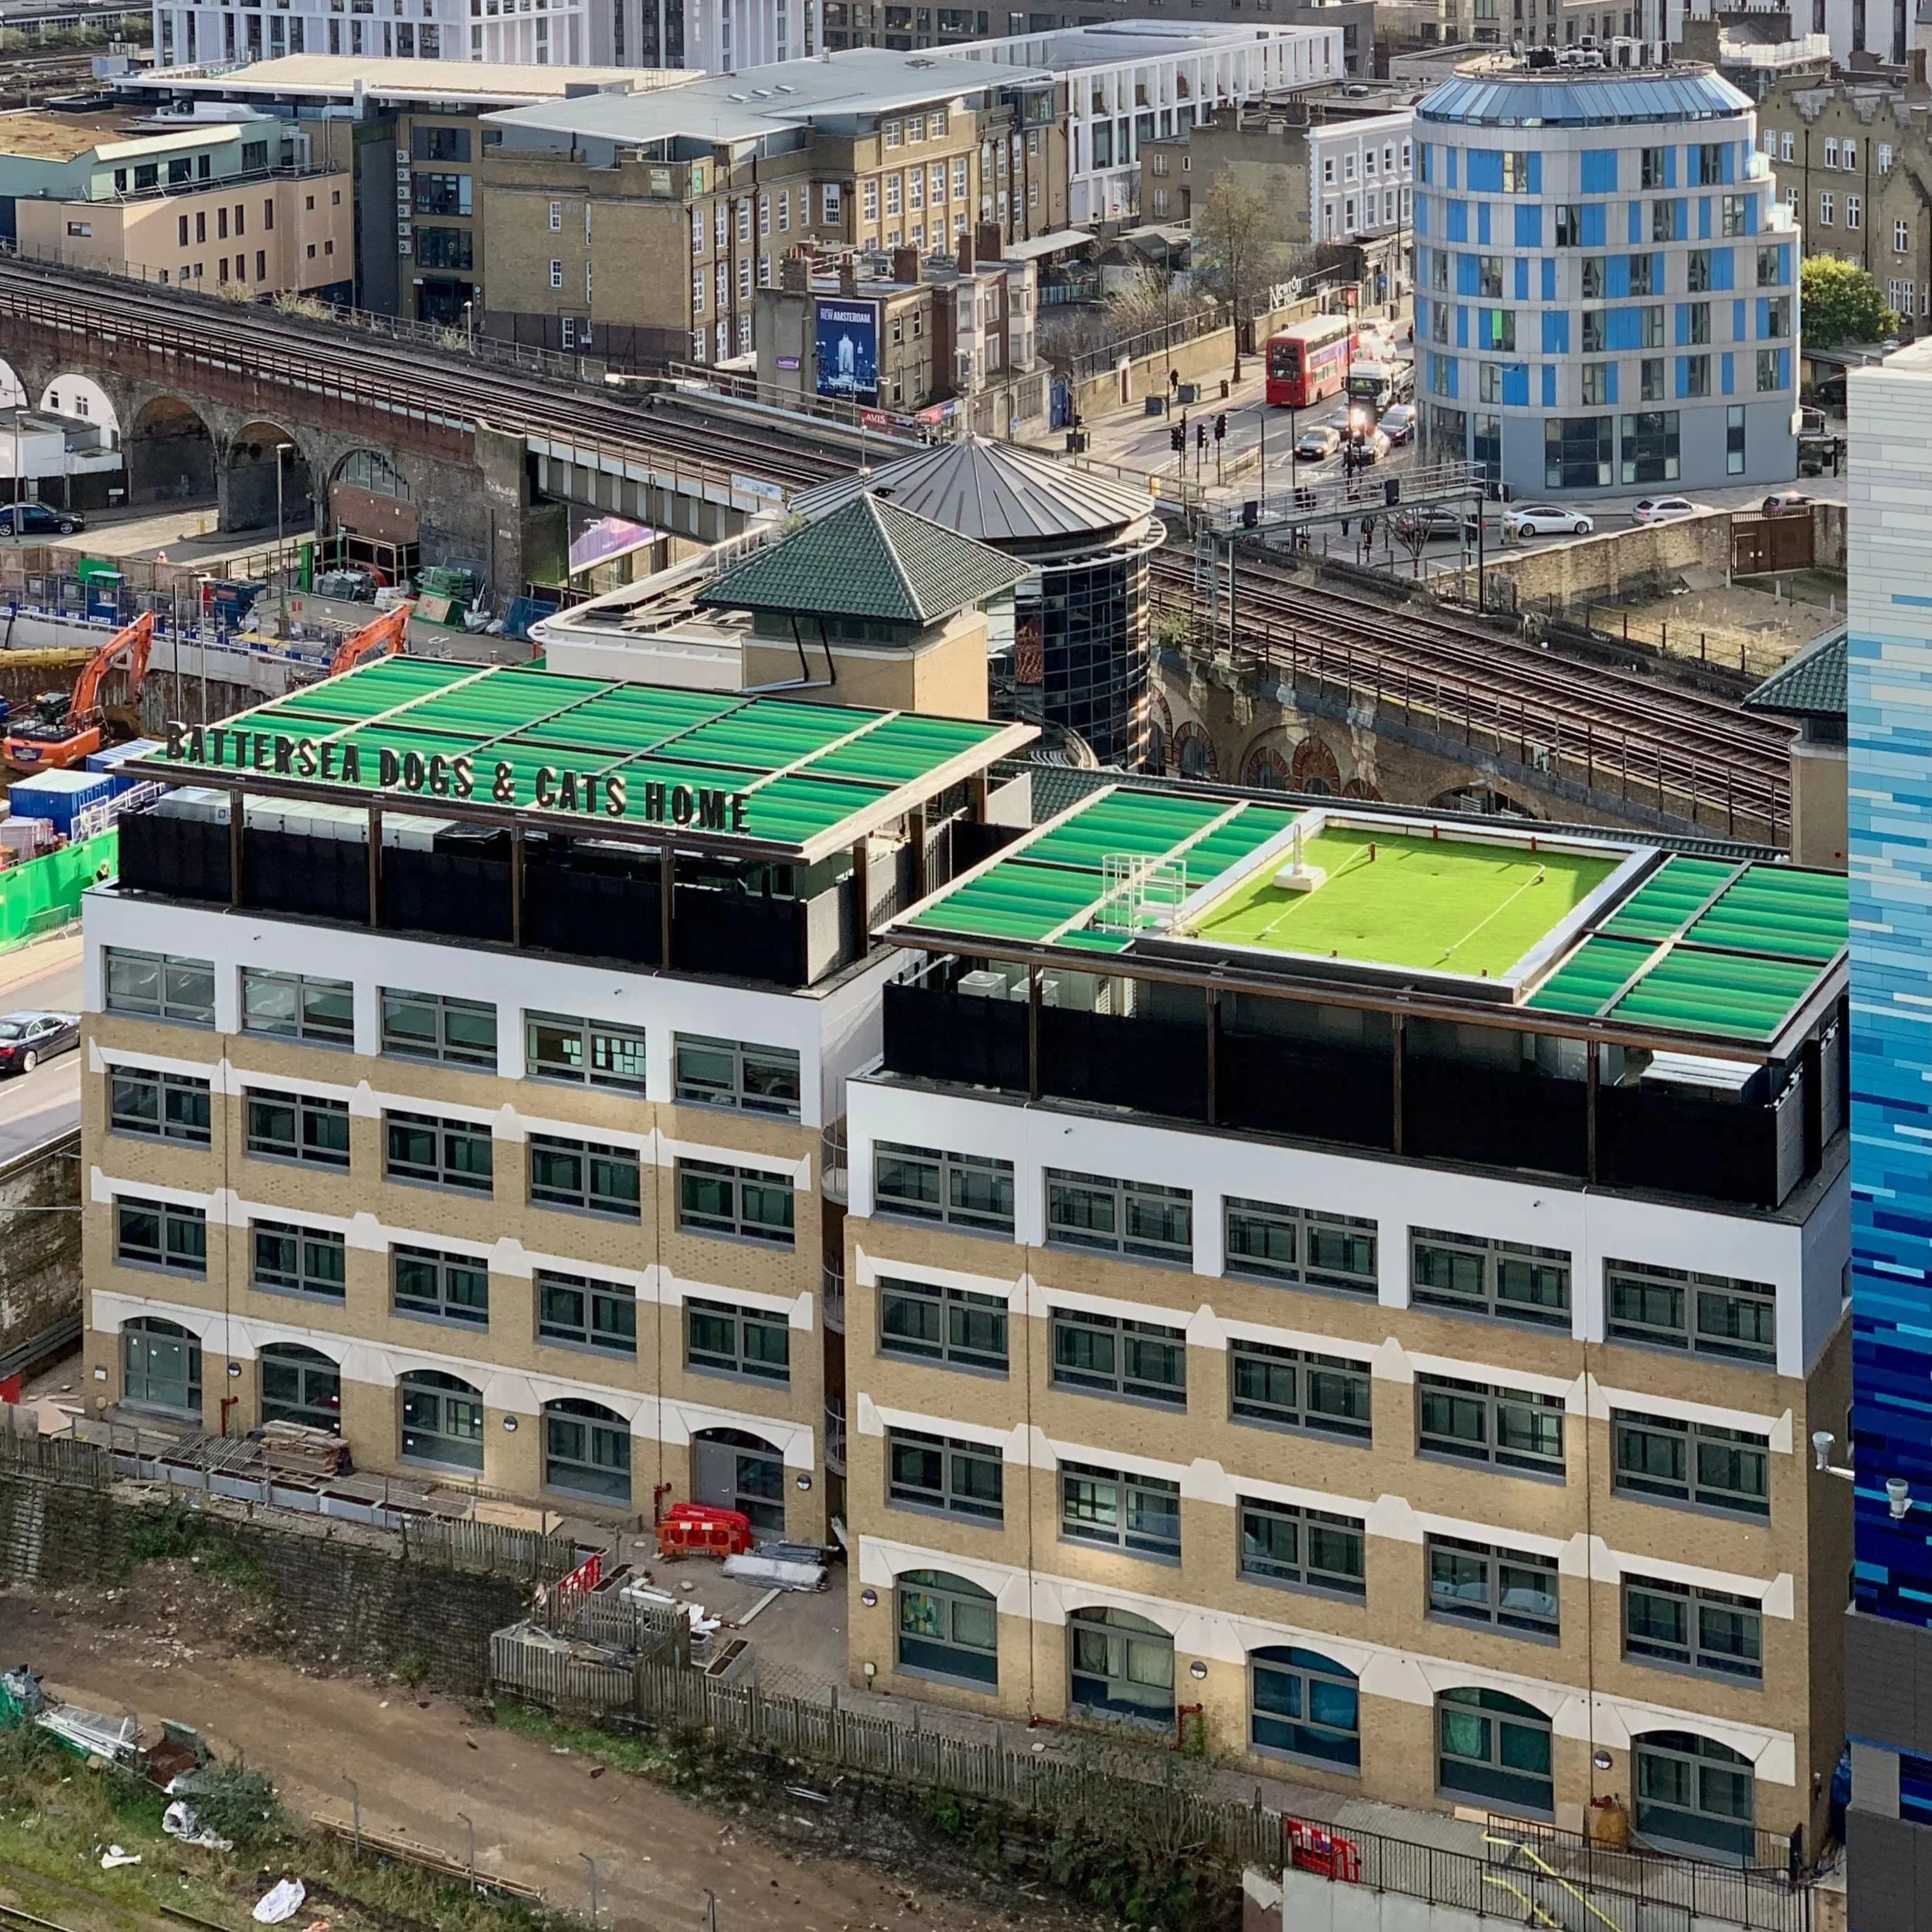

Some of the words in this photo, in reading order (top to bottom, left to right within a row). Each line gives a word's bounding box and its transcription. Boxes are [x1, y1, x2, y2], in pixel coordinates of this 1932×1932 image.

[833, 311, 872, 324] AMSTERDAM
[866, 413, 886, 423] AVIS
[166, 720, 362, 783] BATTERSEA
[379, 747, 474, 798] DOGS
[492, 761, 515, 802] &
[536, 766, 626, 817] CATS
[645, 780, 752, 832] HOME
